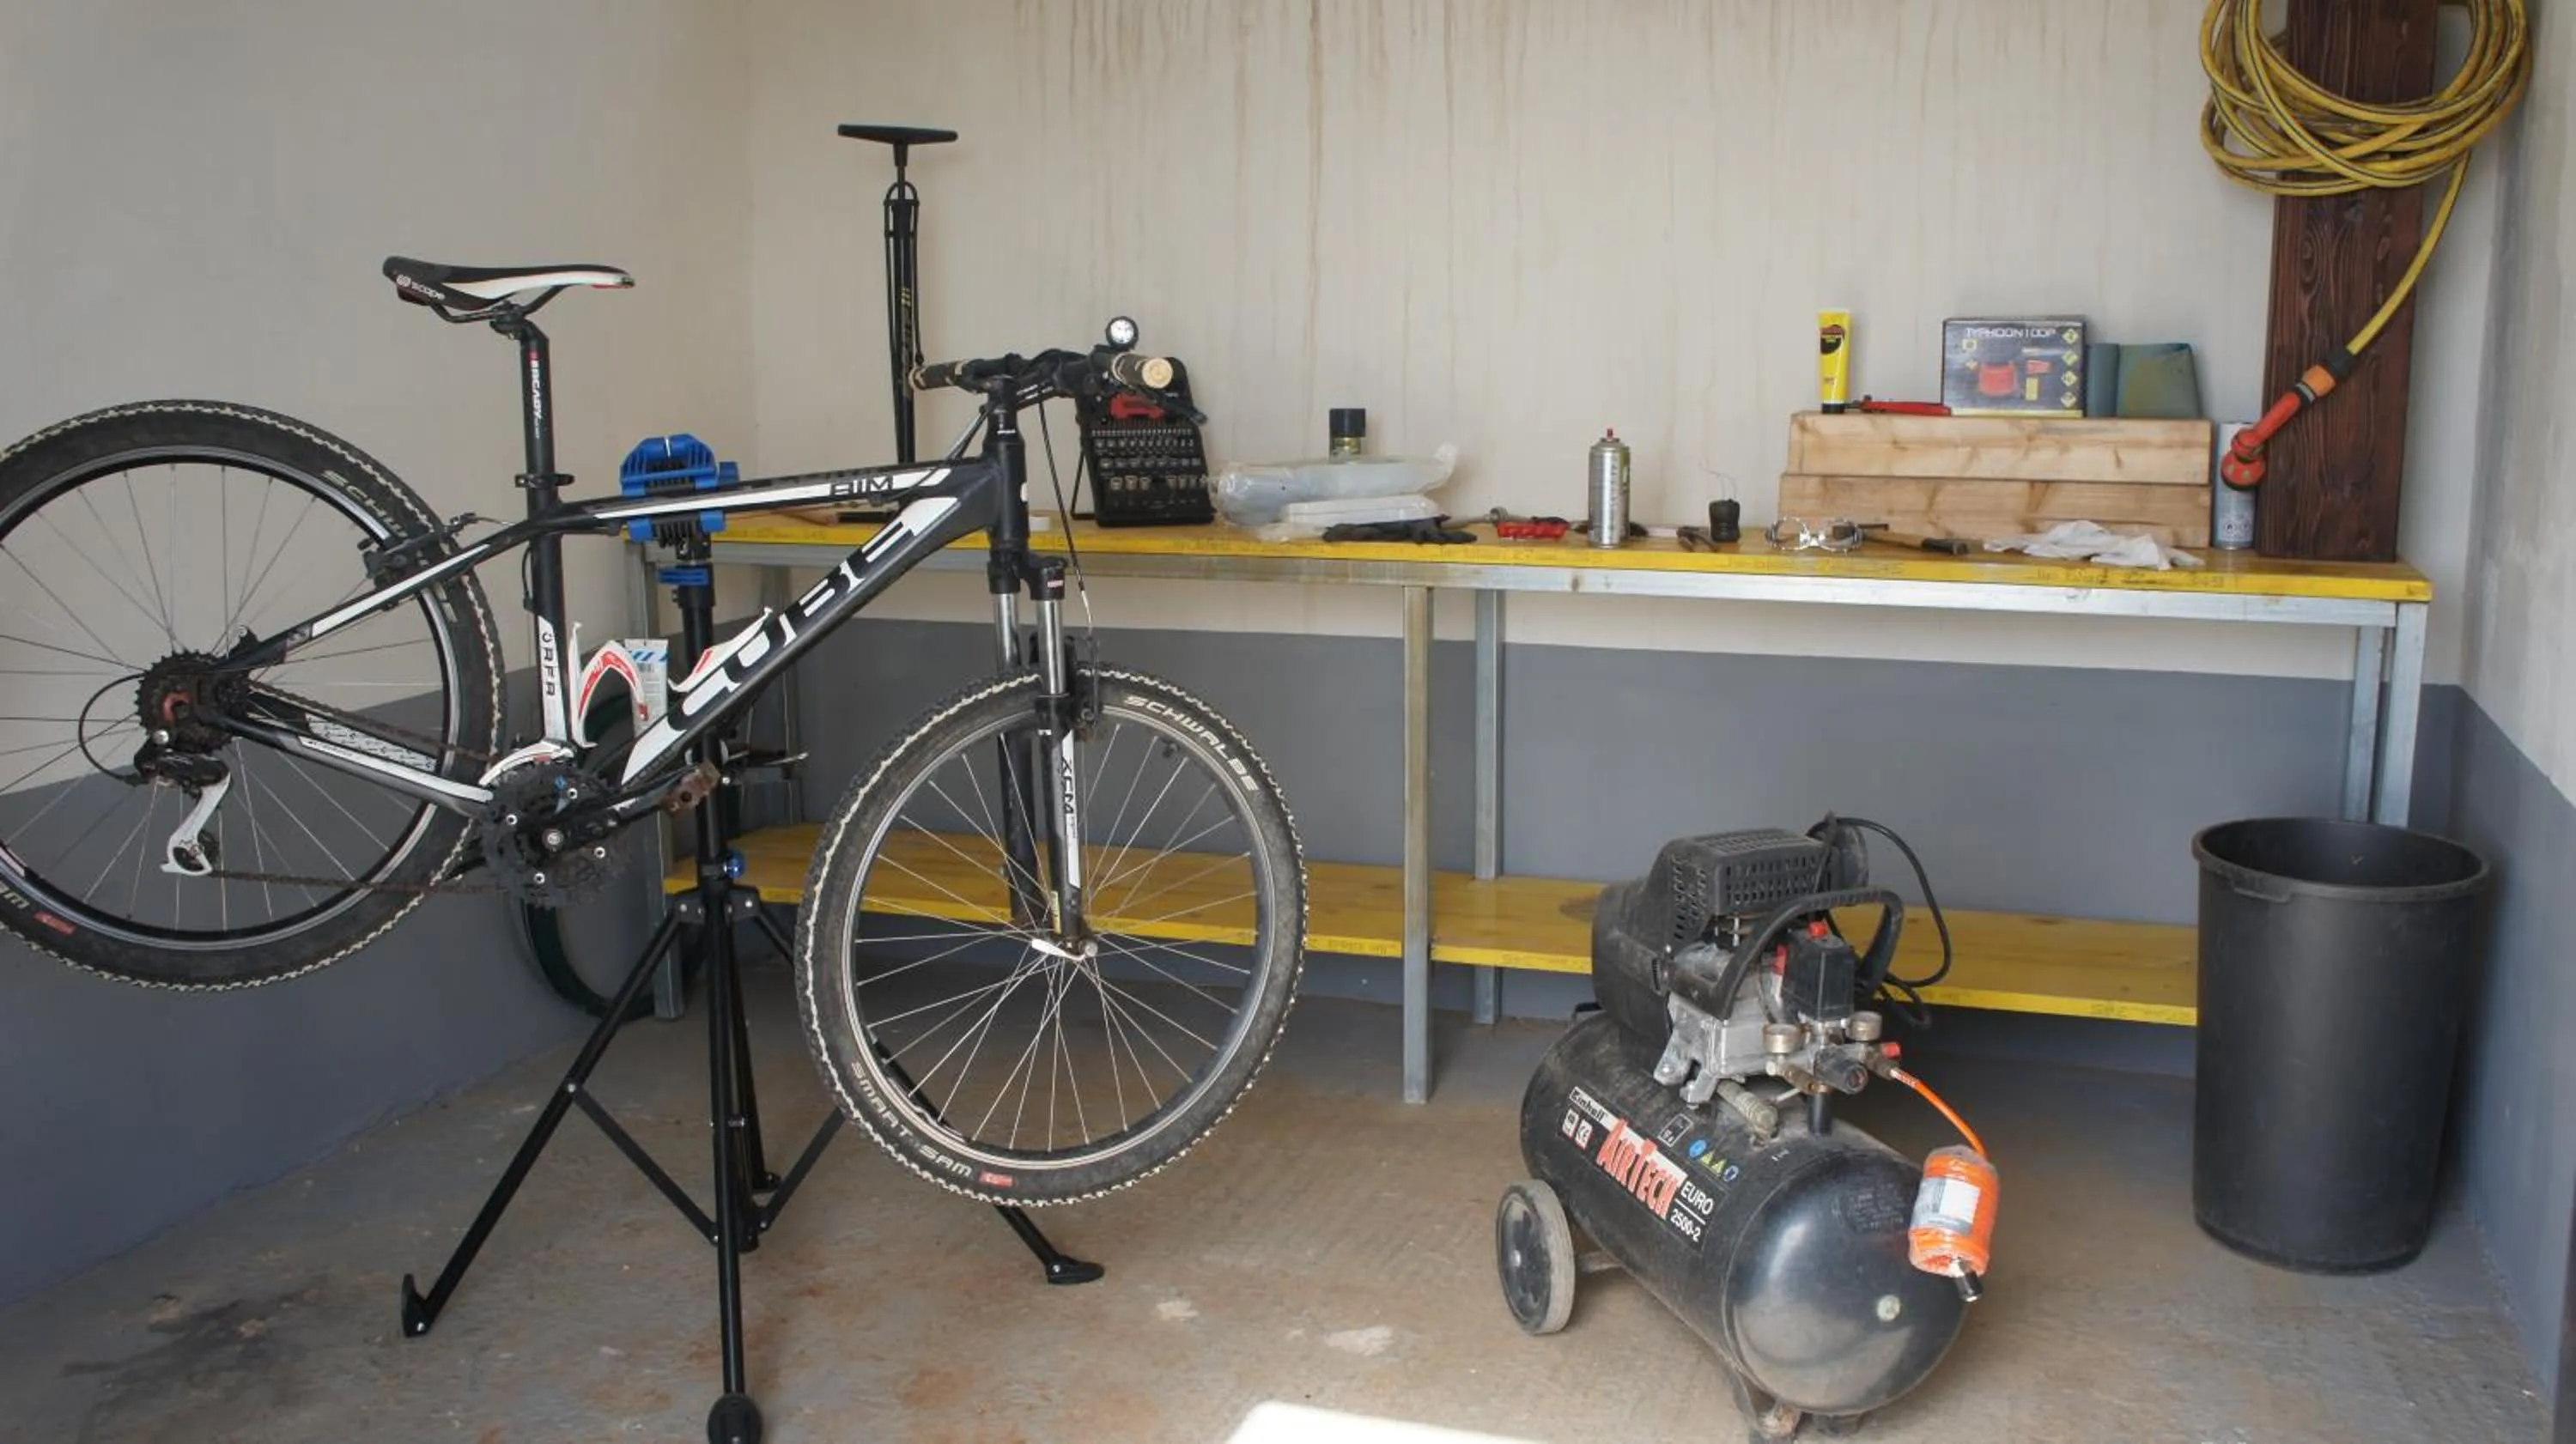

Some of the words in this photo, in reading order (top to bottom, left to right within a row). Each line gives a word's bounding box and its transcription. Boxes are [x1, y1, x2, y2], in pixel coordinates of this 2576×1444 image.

[829, 474, 893, 495] AIM
[667, 513, 915, 732] CUBE
[1124, 695, 1259, 791] SCHWALBE
[852, 1061, 913, 1137] SMART
[920, 1144, 972, 1177] SAM
[1670, 1209, 1702, 1242] 2500-2
[1680, 1180, 1714, 1216] EURO
